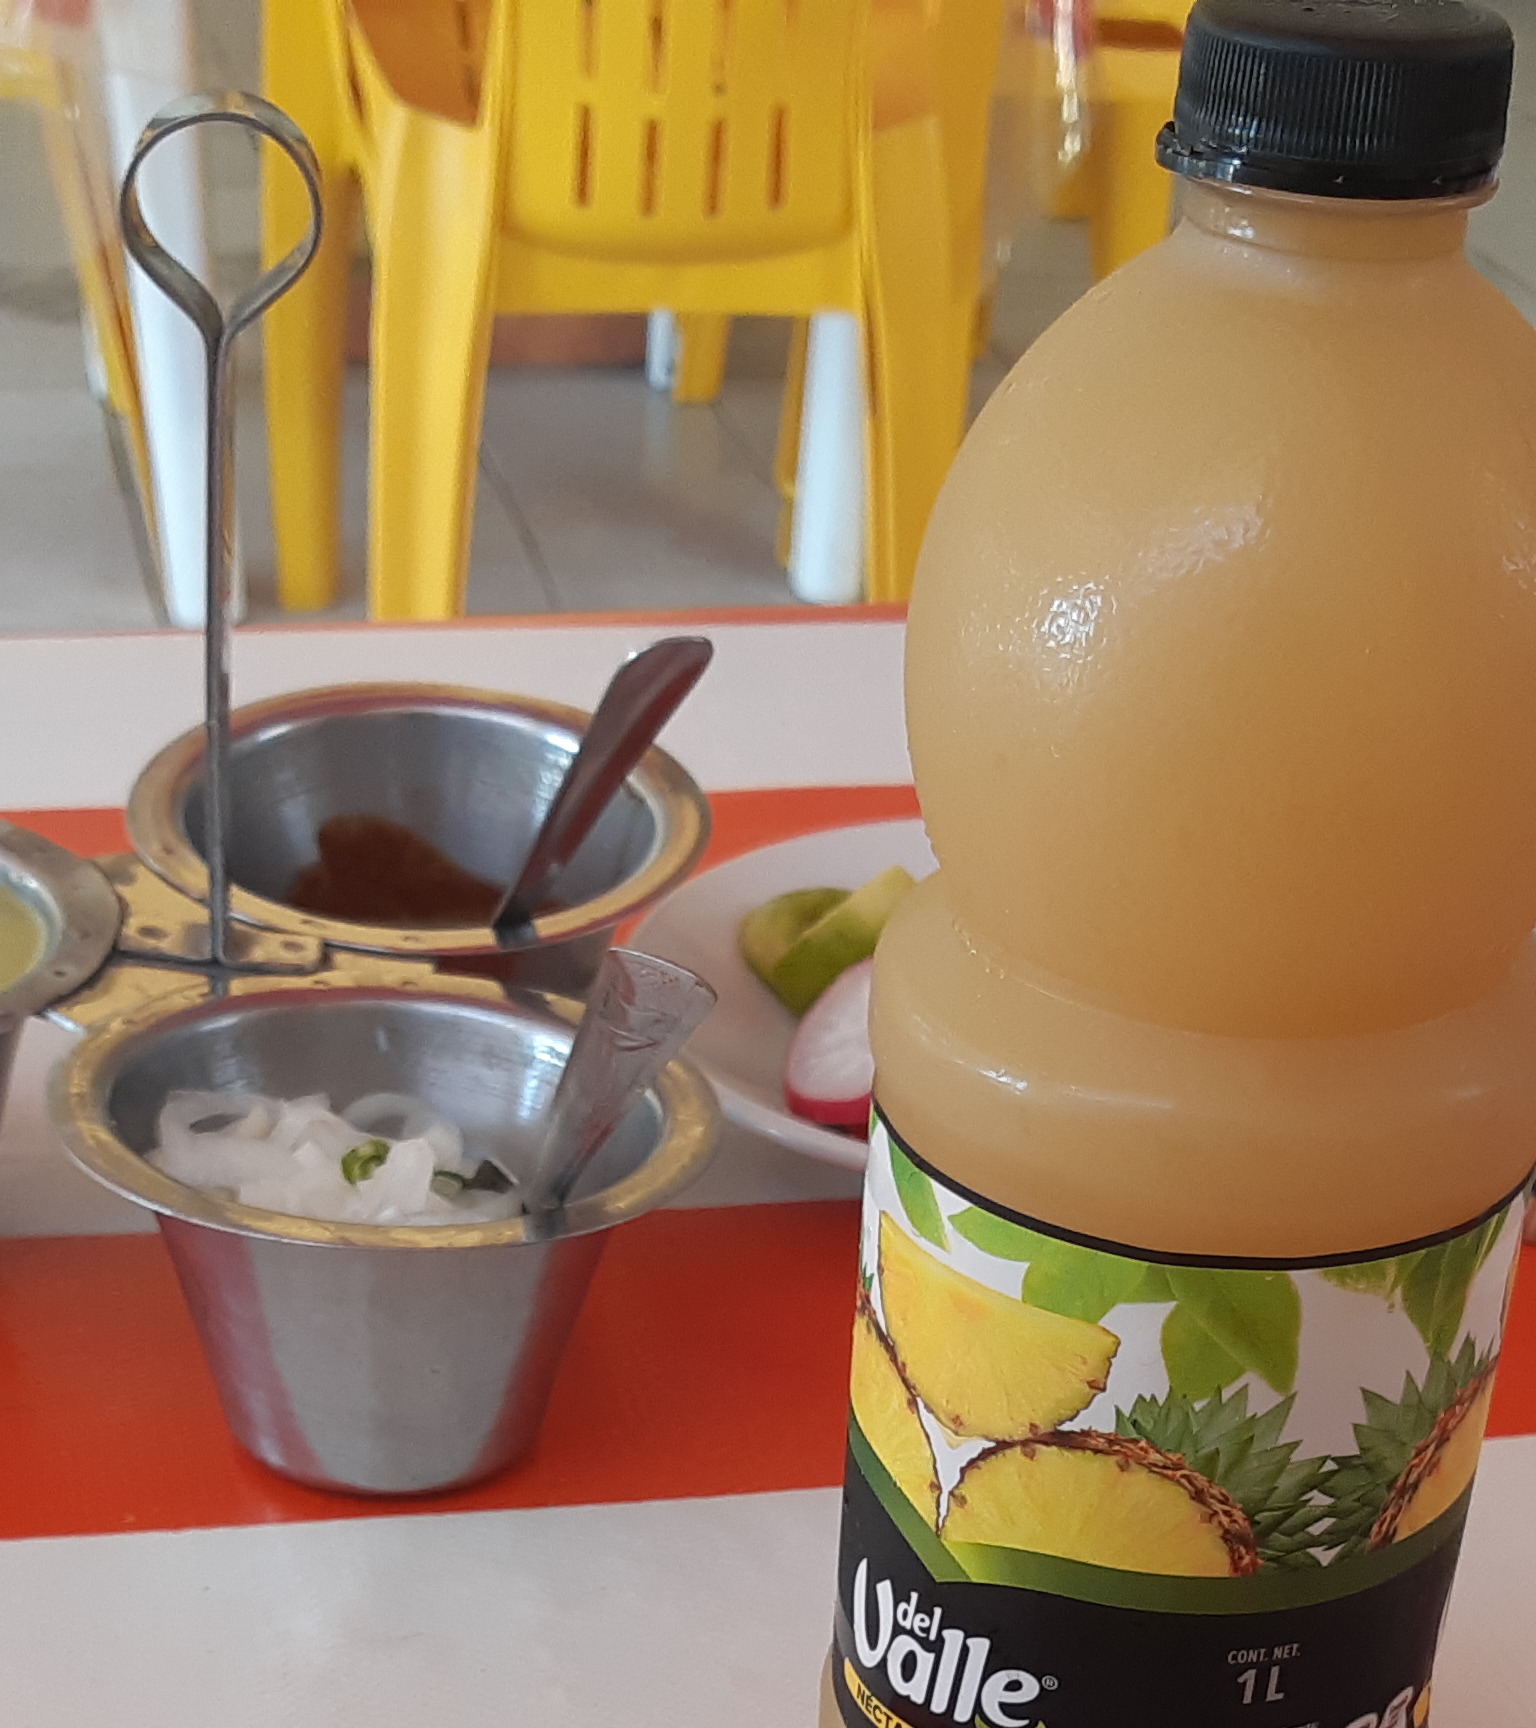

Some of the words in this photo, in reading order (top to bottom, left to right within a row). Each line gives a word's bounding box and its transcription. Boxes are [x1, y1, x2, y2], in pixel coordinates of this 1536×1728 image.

[895, 1590, 943, 1642] del
[853, 1557, 1041, 1728] Valle
[1227, 1648, 1269, 1665] CONT.
[1272, 1642, 1301, 1661] NET.
[1236, 1668, 1257, 1704] 1
[1265, 1664, 1285, 1702] L
